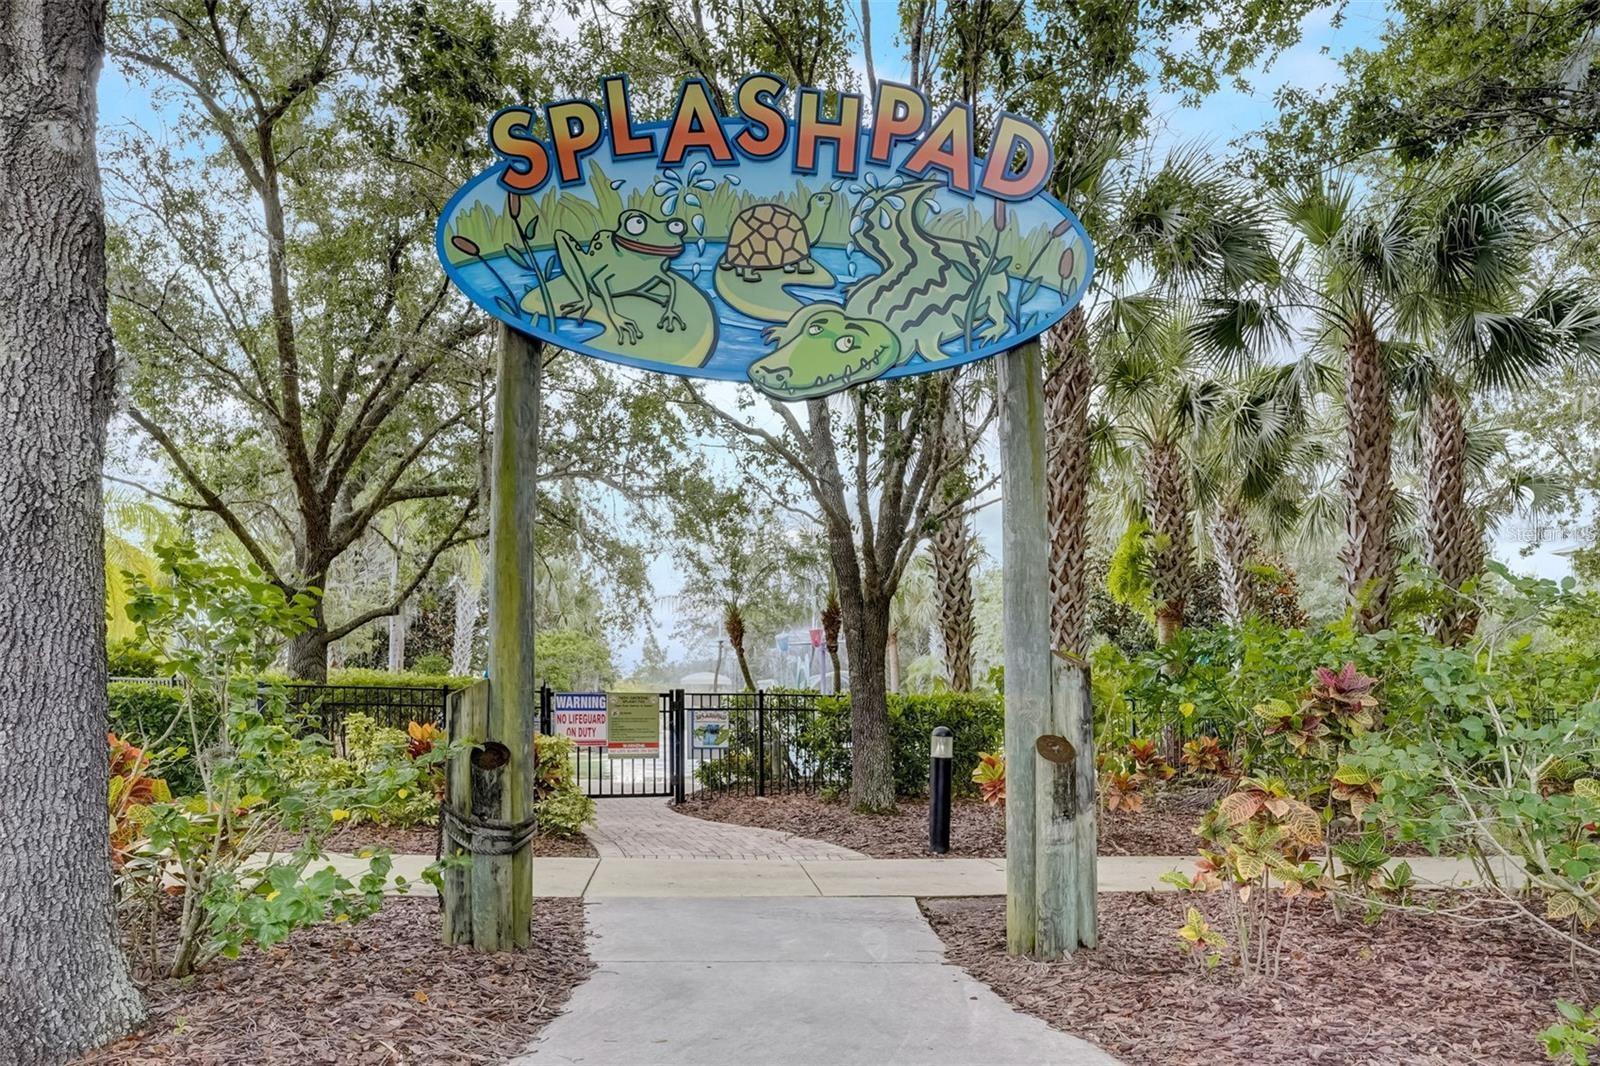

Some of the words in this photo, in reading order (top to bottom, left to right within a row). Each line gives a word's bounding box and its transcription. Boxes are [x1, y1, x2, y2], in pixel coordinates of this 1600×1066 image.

[489, 73, 1055, 201] SPLASHPAD
[556, 695, 607, 709] WARNING
[556, 713, 568, 725] NO
[569, 713, 606, 725] LIFEGUARD
[566, 727, 577, 738] ON
[578, 727, 597, 738] DUTY
